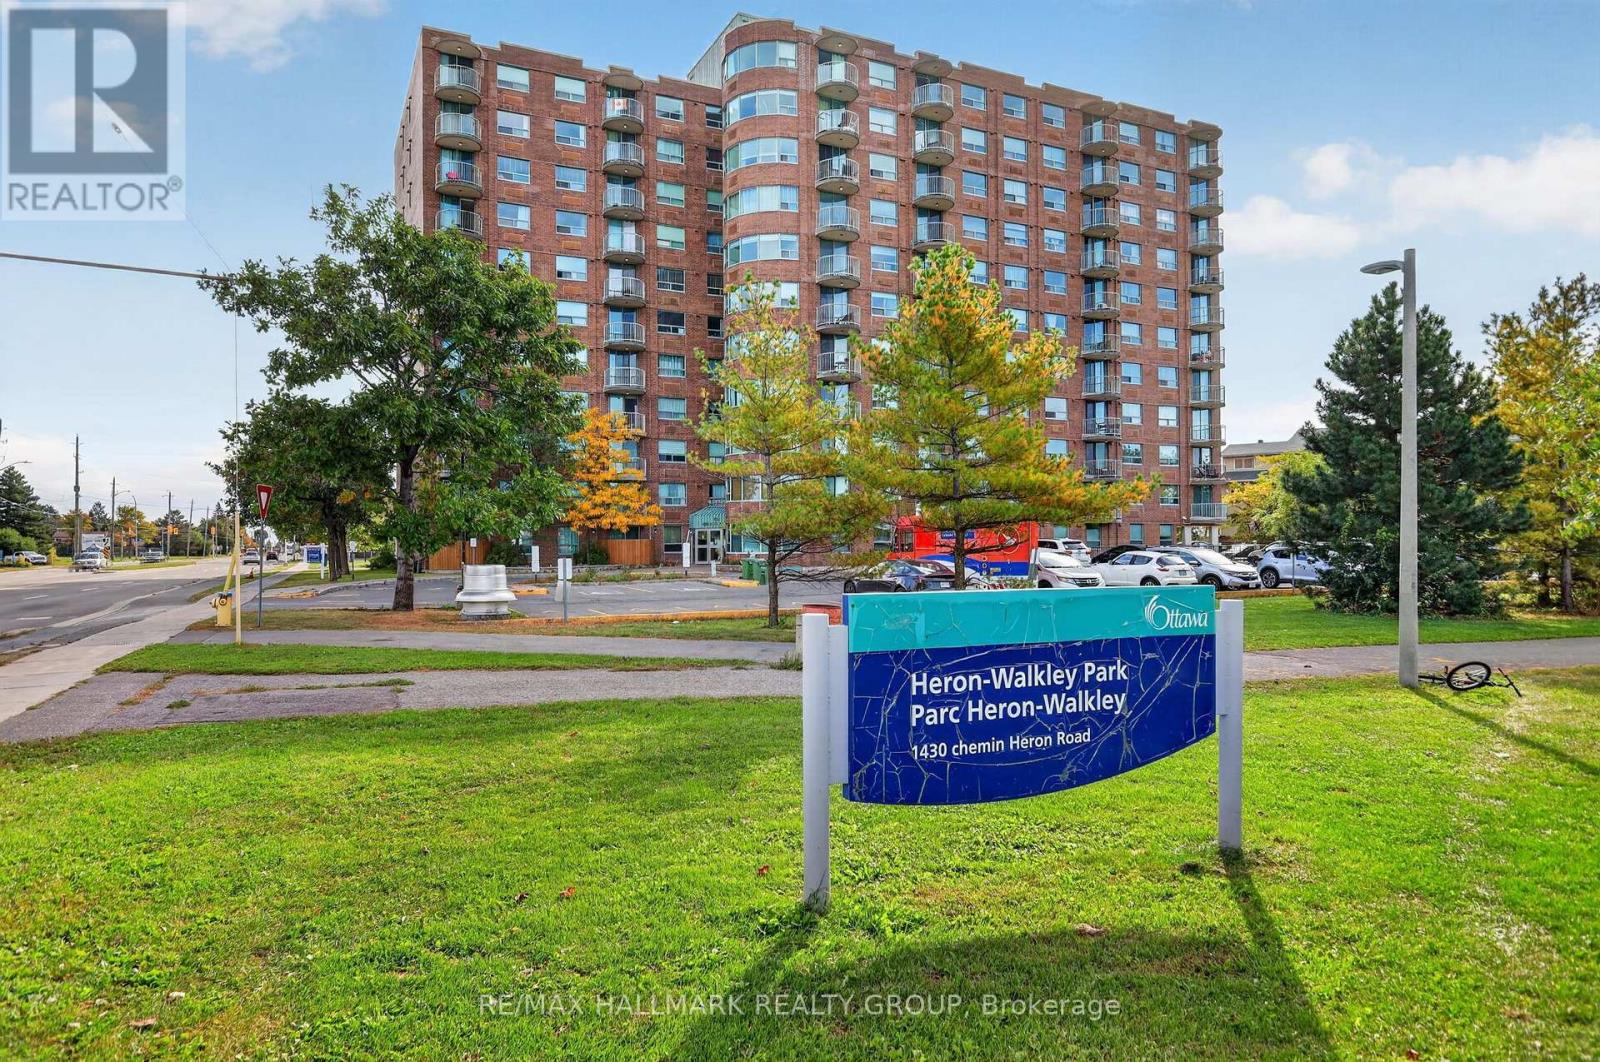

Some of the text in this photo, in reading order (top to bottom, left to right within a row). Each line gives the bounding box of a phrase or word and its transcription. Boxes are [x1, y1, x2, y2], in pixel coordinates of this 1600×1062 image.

[1145, 595, 1208, 630] Ottawa
[911, 660, 1128, 695] Heron-Walkley Park
[911, 689, 1126, 727] Parc Heron-Walkley
[912, 728, 1091, 760] 1430 chemin Heron Road
